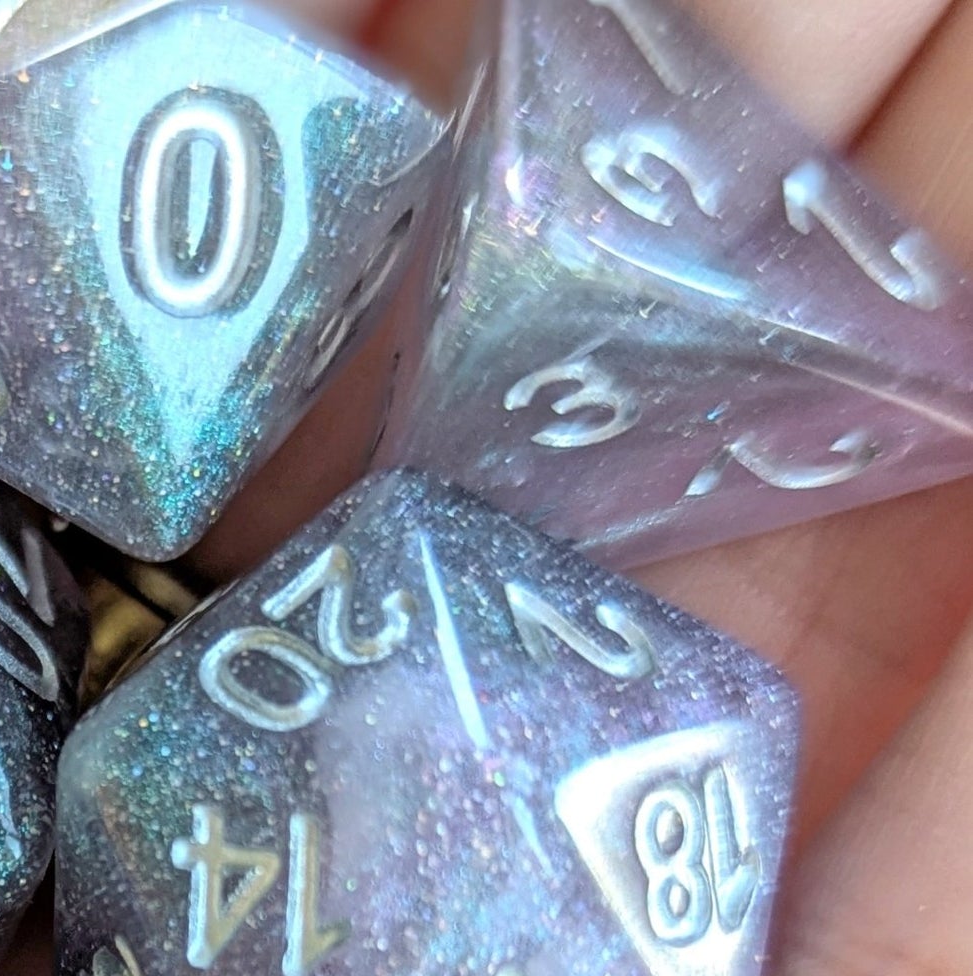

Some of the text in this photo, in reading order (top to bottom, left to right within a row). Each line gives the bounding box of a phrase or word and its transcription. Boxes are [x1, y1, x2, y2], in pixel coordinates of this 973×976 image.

[133, 100, 249, 308] 0
[505, 358, 639, 447] 3
[199, 545, 413, 732] 20
[503, 582, 655, 682] 2
[633, 762, 763, 948] 18
